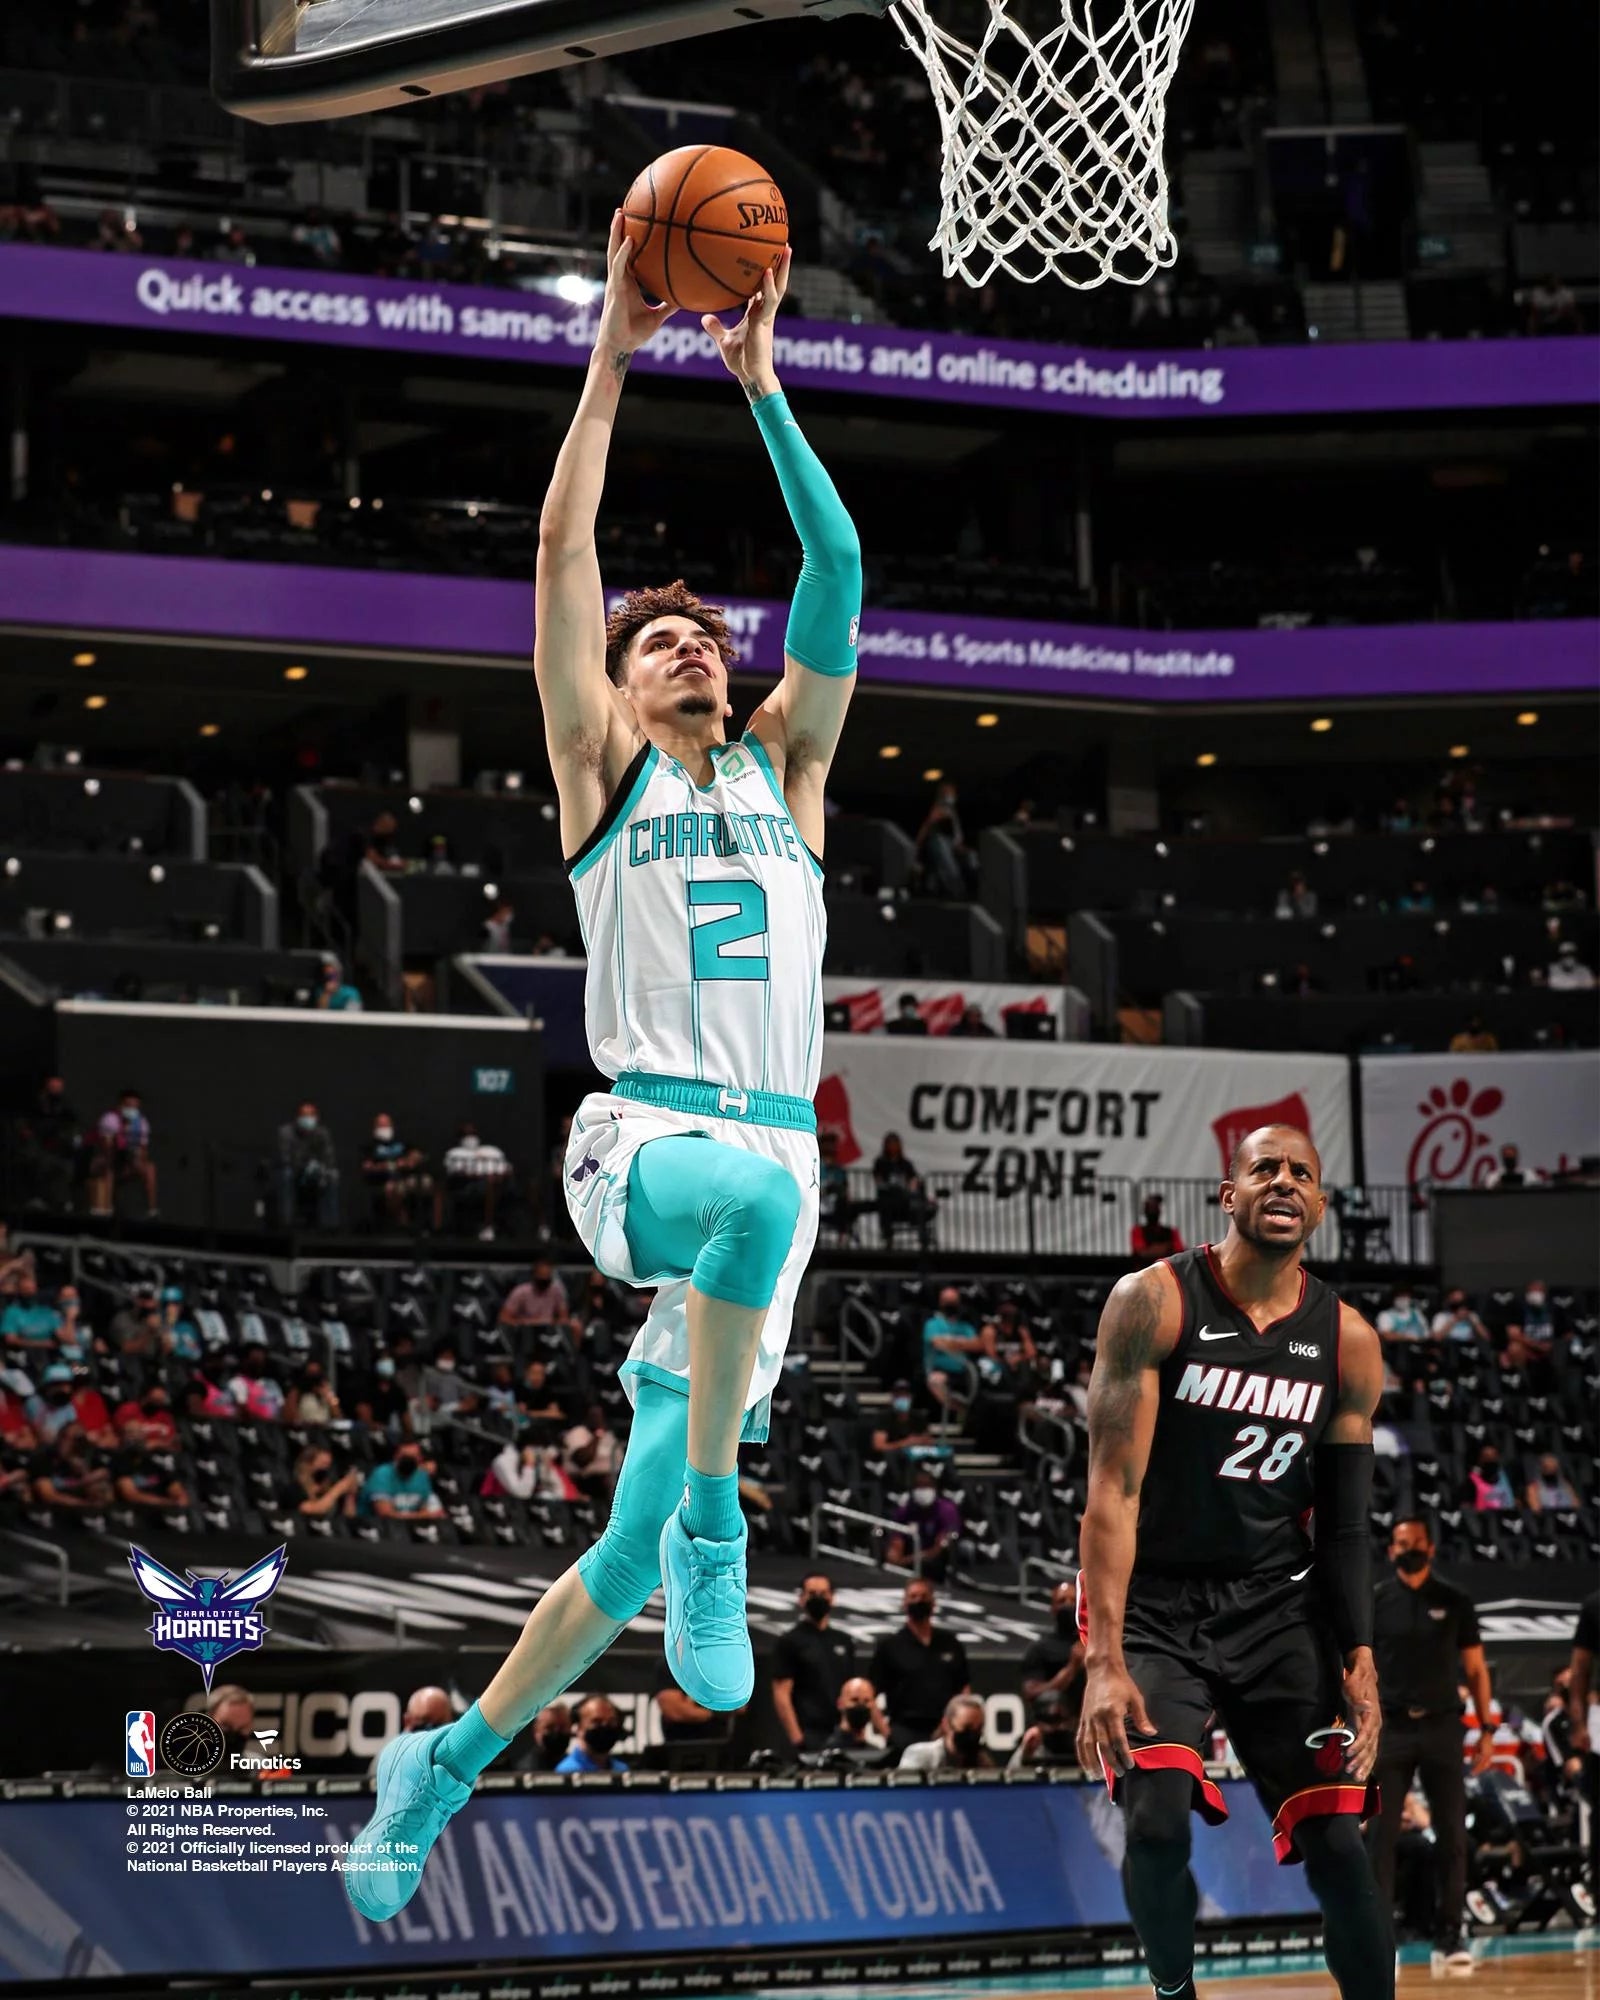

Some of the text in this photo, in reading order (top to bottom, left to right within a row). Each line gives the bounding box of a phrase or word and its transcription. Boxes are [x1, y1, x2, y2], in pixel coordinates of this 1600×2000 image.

[136, 268, 243, 315] Quick
[250, 286, 370, 327] access
[376, 294, 454, 334] with
[869, 340, 933, 380] and
[937, 347, 1037, 391] online
[1041, 357, 1225, 404] scheduling
[857, 627, 928, 660] pedics
[952, 632, 1027, 668] Sports
[1028, 639, 1131, 675] Medicine
[1133, 647, 1236, 677] Institute
[629, 812, 798, 868] CHARLOTTE
[688, 879, 768, 981] 2
[477, 1068, 511, 1093] 107
[909, 1082, 1163, 1139] COMFORT
[961, 1145, 1104, 1201] ZONE
[1174, 1362, 1325, 1424] MIAMI
[1217, 1423, 1306, 1482] 28
[183, 1691, 401, 1757] EICO
[473, 1814, 832, 1940] AMSTERDAM
[813, 1808, 1006, 1921] VODKA
